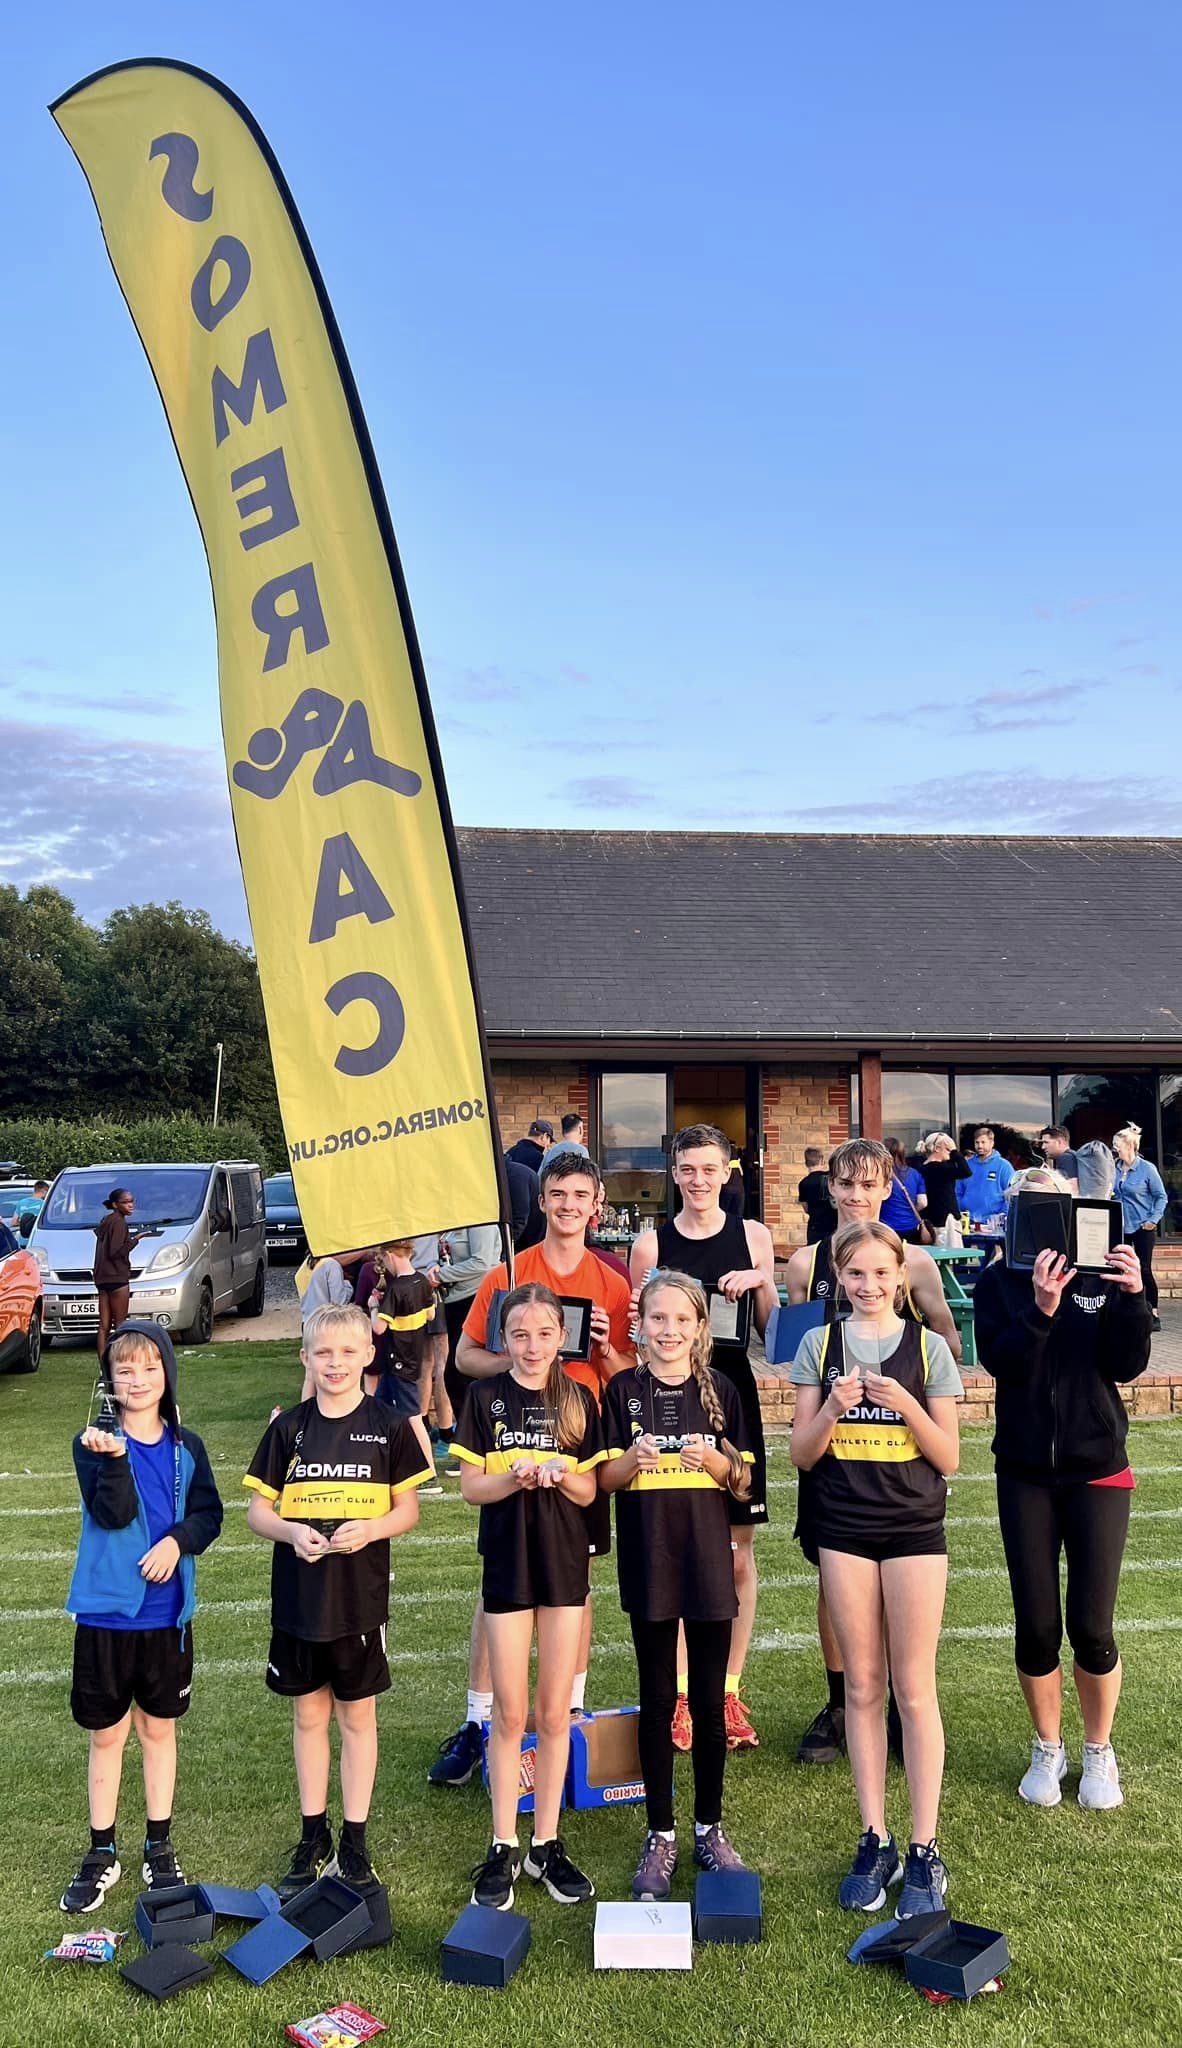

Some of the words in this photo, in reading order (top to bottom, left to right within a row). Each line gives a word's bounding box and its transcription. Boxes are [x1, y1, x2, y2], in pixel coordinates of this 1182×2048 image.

[71, 1304, 96, 1313] CX56
[350, 1433, 387, 1444] LUCAS
[502, 1431, 560, 1449] SOME
[295, 1463, 372, 1479] SOMER
[640, 1467, 691, 1475] THLETIC
